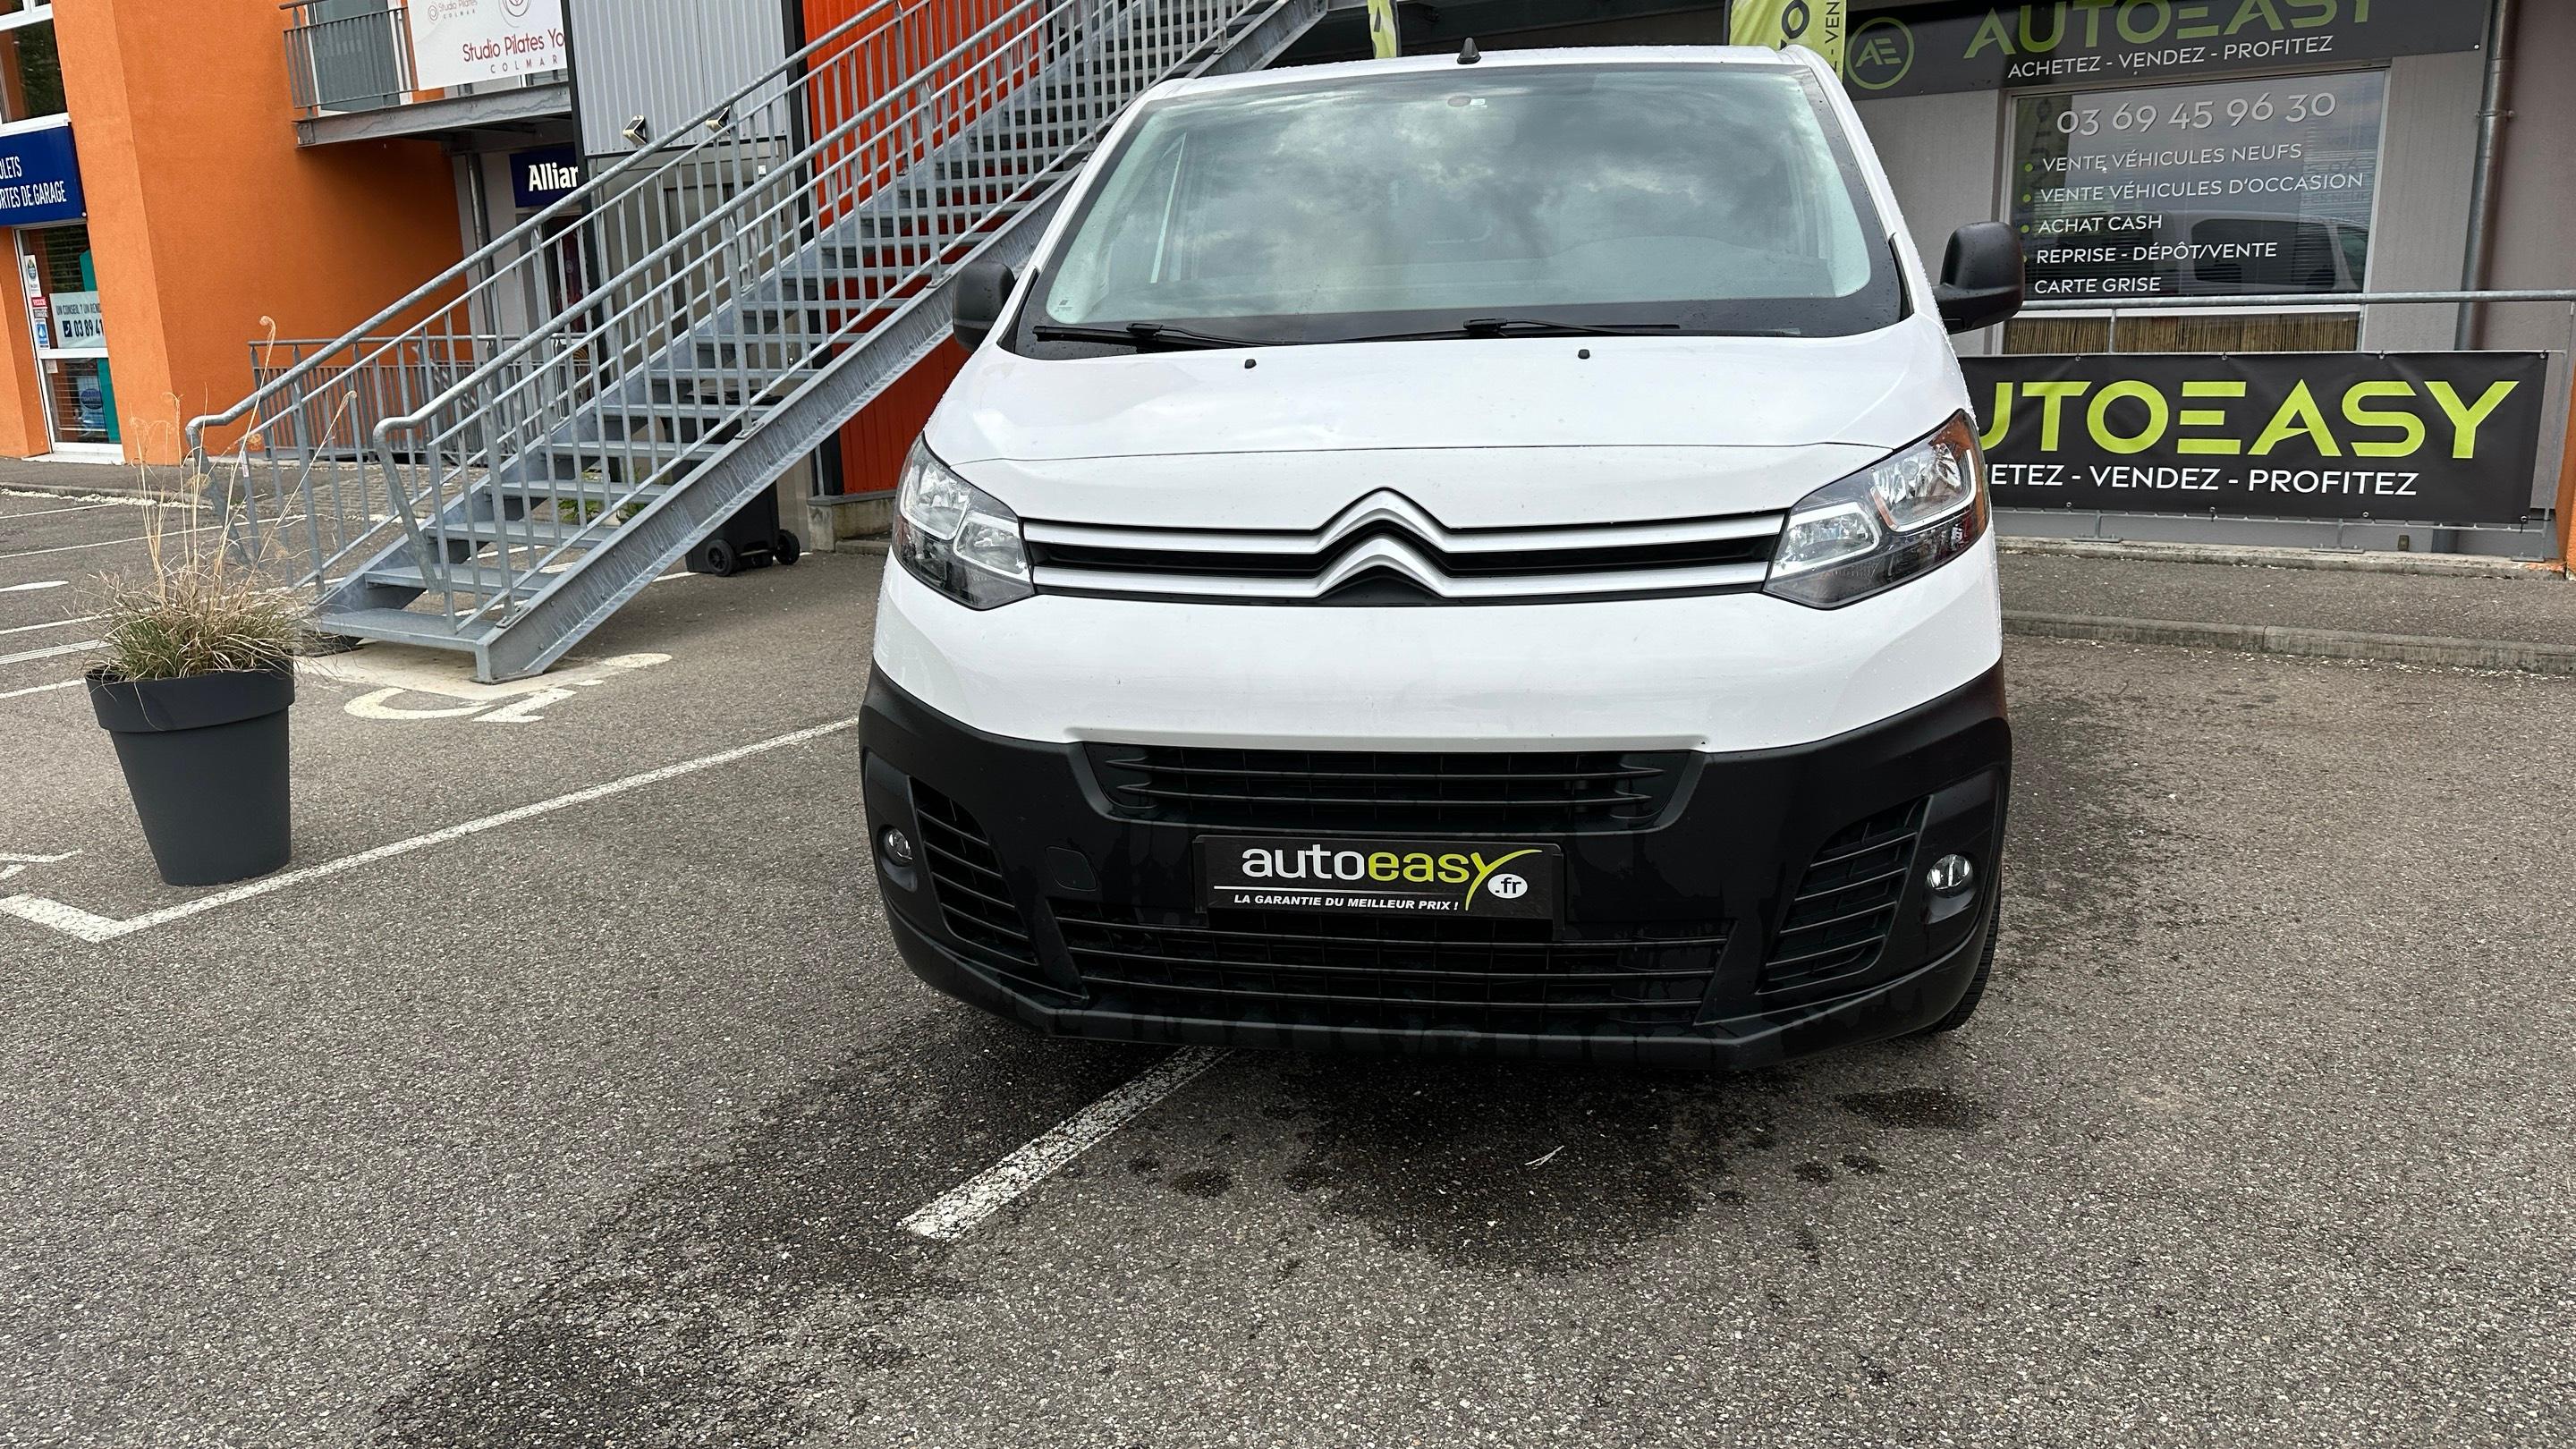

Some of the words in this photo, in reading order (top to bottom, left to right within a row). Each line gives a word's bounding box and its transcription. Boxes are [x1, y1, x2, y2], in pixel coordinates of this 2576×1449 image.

[462, 38, 501, 62] Studio
[504, 33, 545, 55] Pilates
[2007, 55, 2102, 79] ACHETEZ
[2118, 47, 2206, 69] VENDEZ
[2224, 35, 2334, 60] PROFITEZ
[490, 55, 558, 73] COLMAR
[2057, 108, 2102, 136] 03
[2112, 100, 2158, 133] 69
[2168, 101, 2214, 130] 45
[2226, 92, 2275, 127] 96
[2285, 92, 2337, 123] 30
[2043, 155, 2107, 173] VENTE
[2112, 148, 2225, 168] VÉHICULES
[2231, 143, 2302, 163] NEUFS
[21, 184, 34, 207] DE
[33, 180, 67, 206] GARAGE
[2040, 186, 2105, 202] VENTE
[2110, 180, 2223, 199] VÉHICULES
[2229, 173, 2364, 194] D'OCCASION
[2038, 217, 2104, 233] ACHAT
[2108, 214, 2163, 231] CASH
[2037, 247, 2117, 264] REPRISE
[2132, 242, 2278, 261] DÉPÔT/VENTE
[2034, 278, 2097, 294] CARTE
[2102, 276, 2162, 292] GRISE
[73, 319, 83, 337] 03
[84, 318, 93, 337] 89
[1985, 463, 2064, 486] ETEZ
[2089, 465, 2221, 491] VENDEZ
[2249, 469, 2419, 496] PROFITEZ
[1241, 843, 1543, 911] autoeasy
[1234, 894, 1250, 904] LA
[1254, 895, 1322, 906] GARANTIE
[1325, 897, 1343, 908] DU
[1347, 898, 1415, 910] MEILLEUR
[1418, 901, 1450, 911] PRIX
